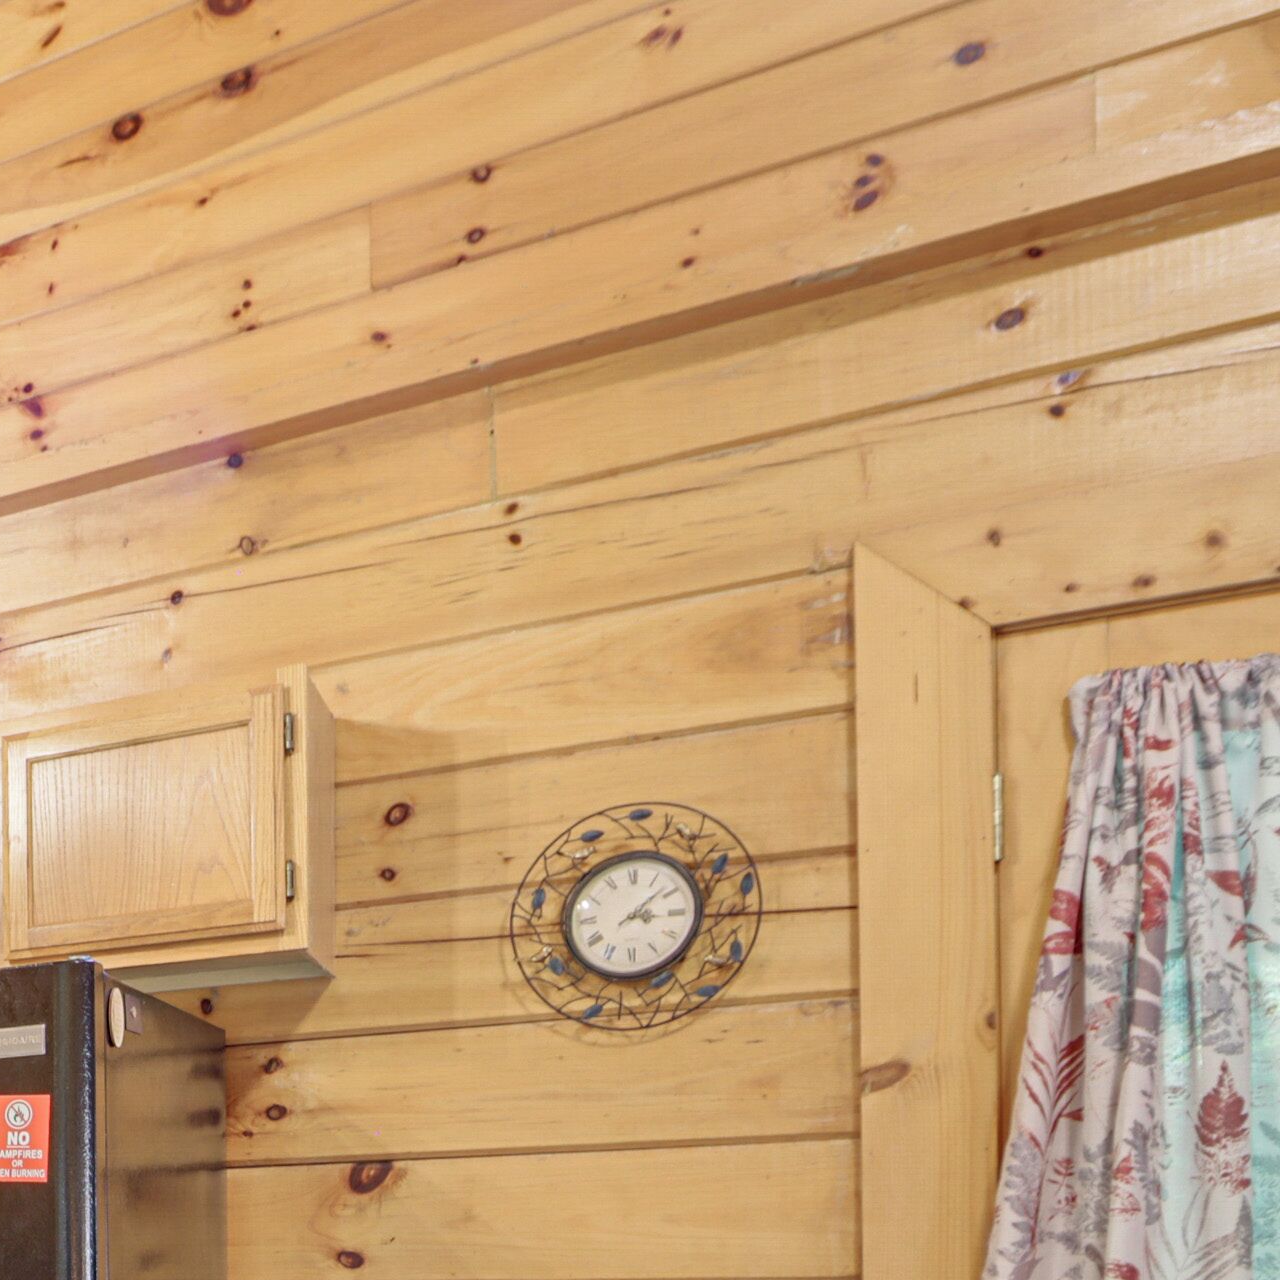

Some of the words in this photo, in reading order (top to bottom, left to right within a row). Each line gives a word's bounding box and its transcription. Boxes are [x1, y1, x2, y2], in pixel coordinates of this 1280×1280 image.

[7, 1131, 30, 1146] NO
[11, 1159, 24, 1168] OR
[11, 1168, 45, 1178] BURNING
